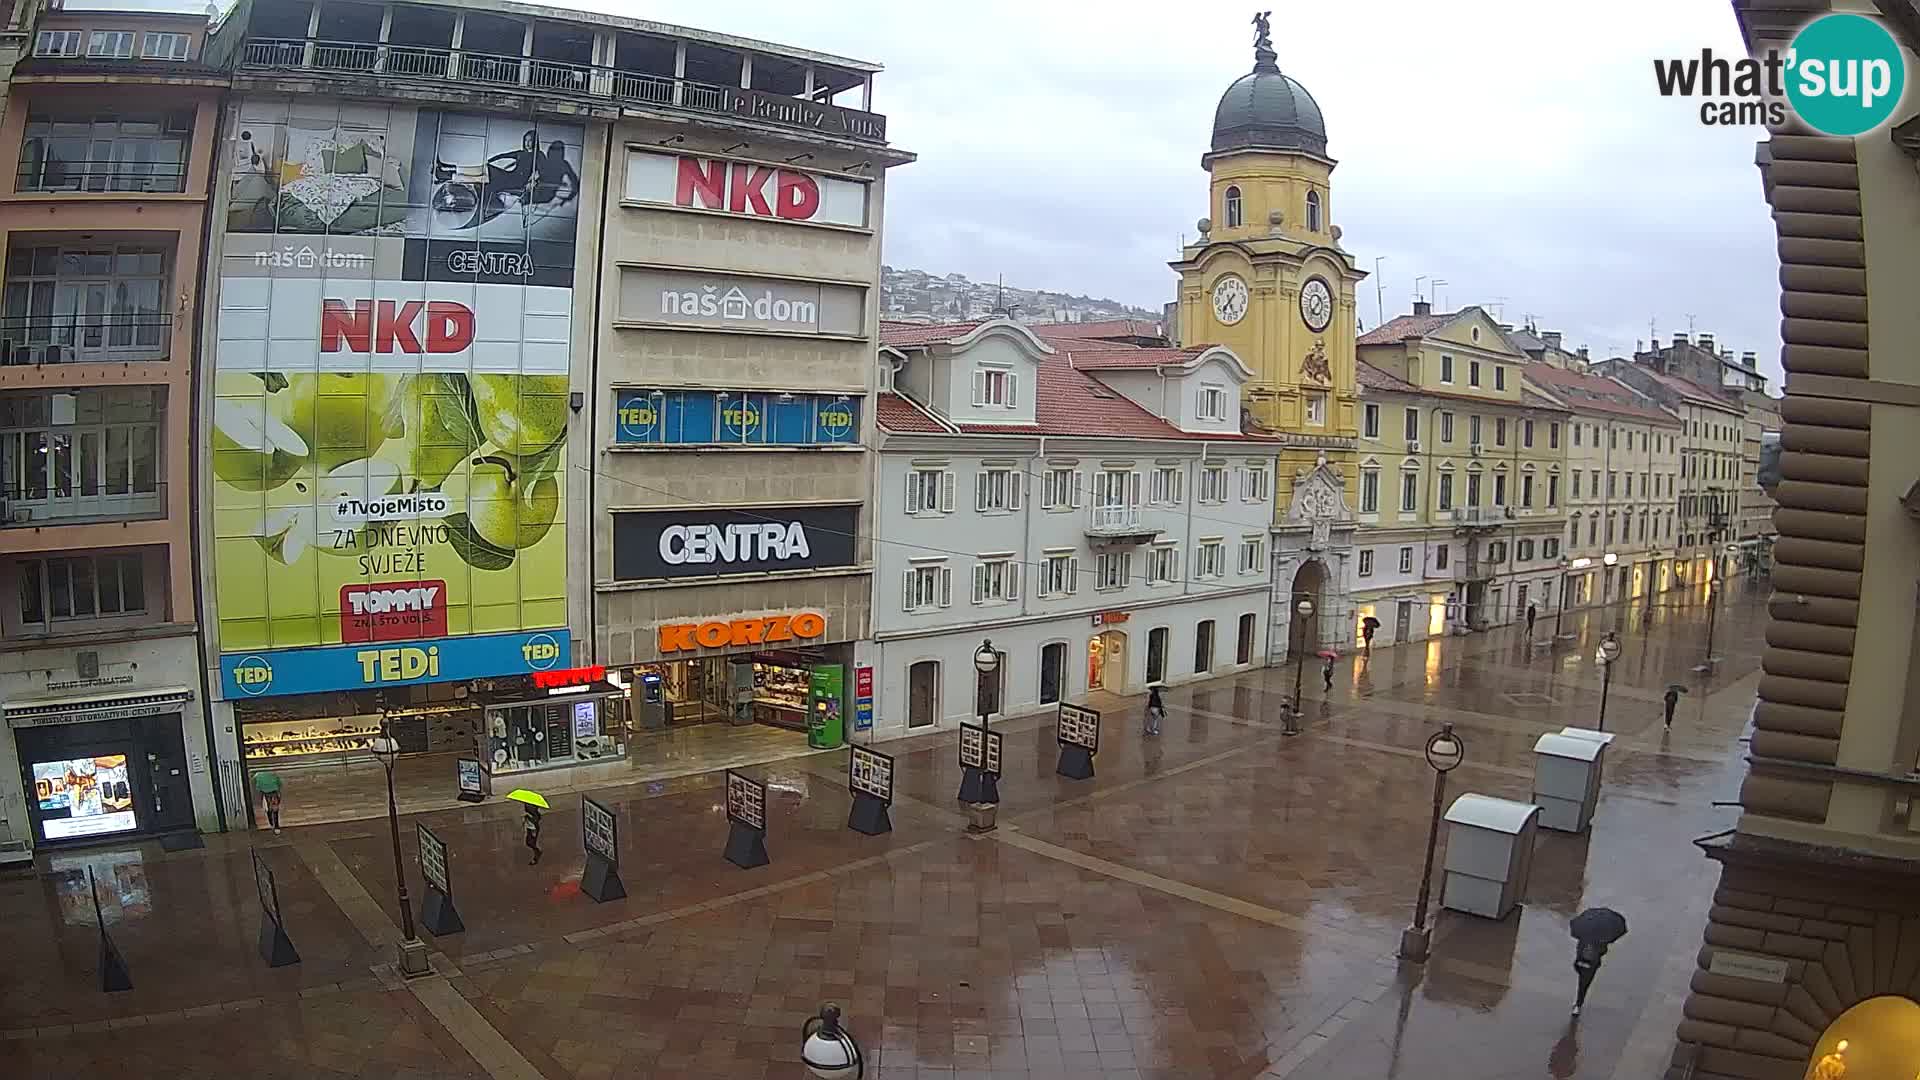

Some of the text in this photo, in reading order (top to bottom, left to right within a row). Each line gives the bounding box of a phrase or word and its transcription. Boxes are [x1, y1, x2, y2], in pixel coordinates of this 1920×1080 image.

[675, 157, 821, 220] NKD
[254, 244, 366, 270] naš dom
[447, 250, 535, 277] CENTRA
[661, 285, 817, 323] naš dom
[319, 297, 477, 354] NKD
[619, 408, 656, 425] TEDi
[723, 409, 760, 426] TEDi
[820, 411, 852, 426] TEDi
[338, 497, 446, 516] #TvojeMisto
[333, 523, 450, 550] ZA DNEVNO
[659, 521, 810, 564] CENTRA
[359, 547, 426, 576] SVJEŽE
[348, 586, 439, 615] TOMMY
[659, 612, 825, 653] KORZO
[357, 645, 440, 684] TEDi
[522, 641, 560, 661] TEDi
[233, 667, 273, 685] TEDi
